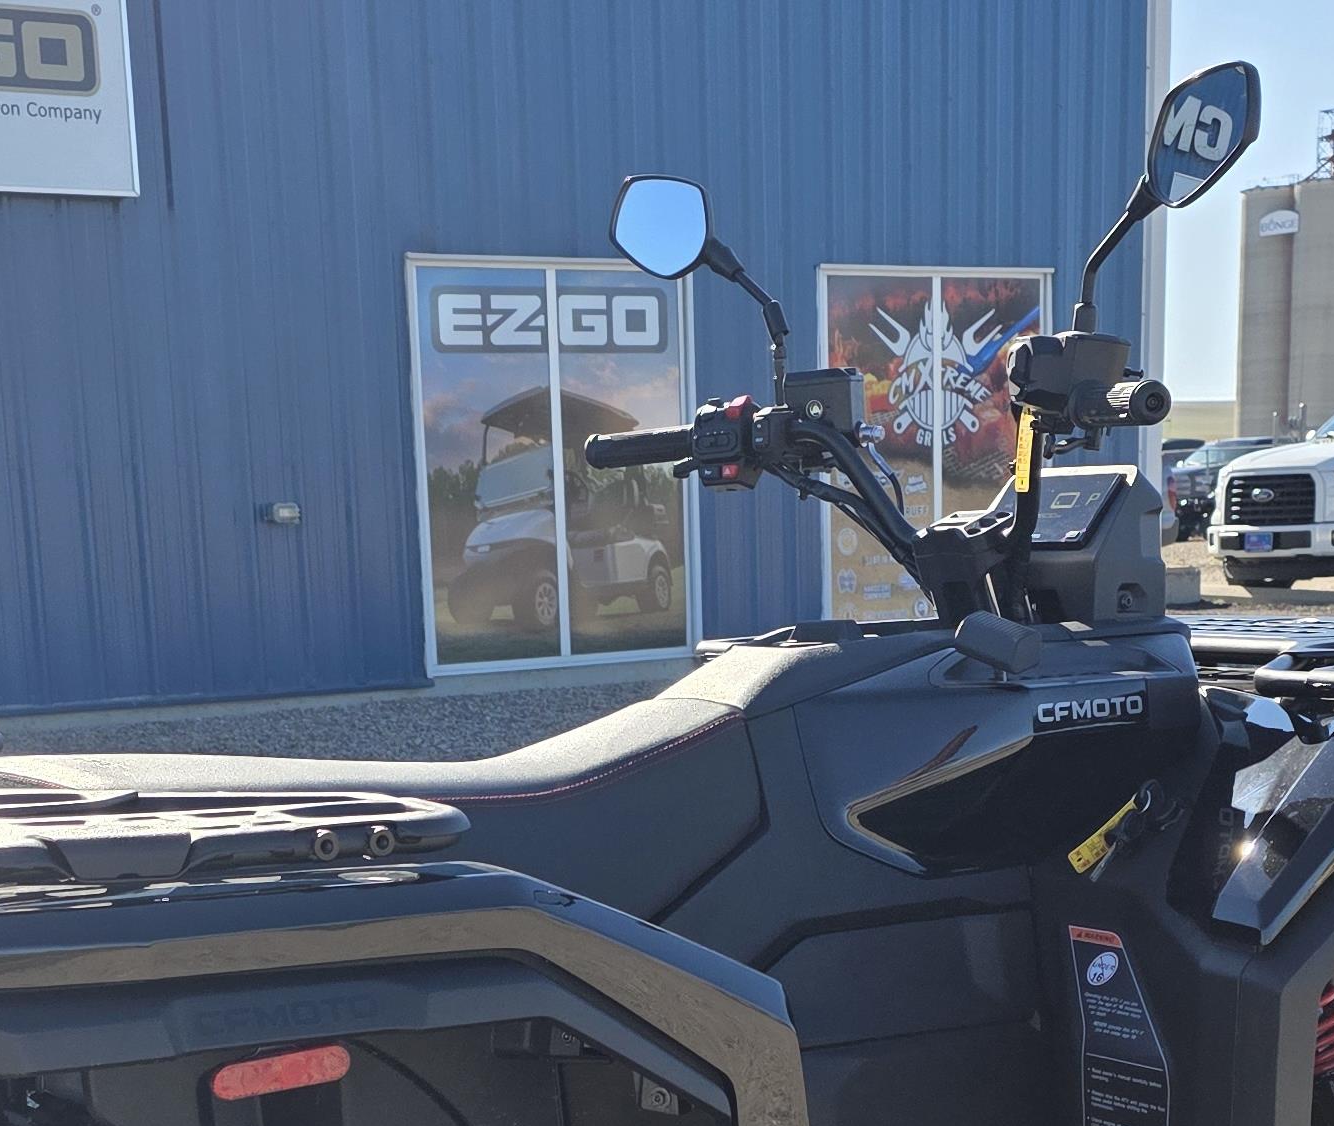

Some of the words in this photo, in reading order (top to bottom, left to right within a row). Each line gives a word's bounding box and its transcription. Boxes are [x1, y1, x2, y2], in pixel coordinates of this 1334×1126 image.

[26, 102, 102, 123] Company
[437, 294, 660, 346] EZGO
[916, 427, 957, 447] GRLS
[1038, 695, 1143, 723] CFMOTO
[1092, 972, 1104, 983] 16
